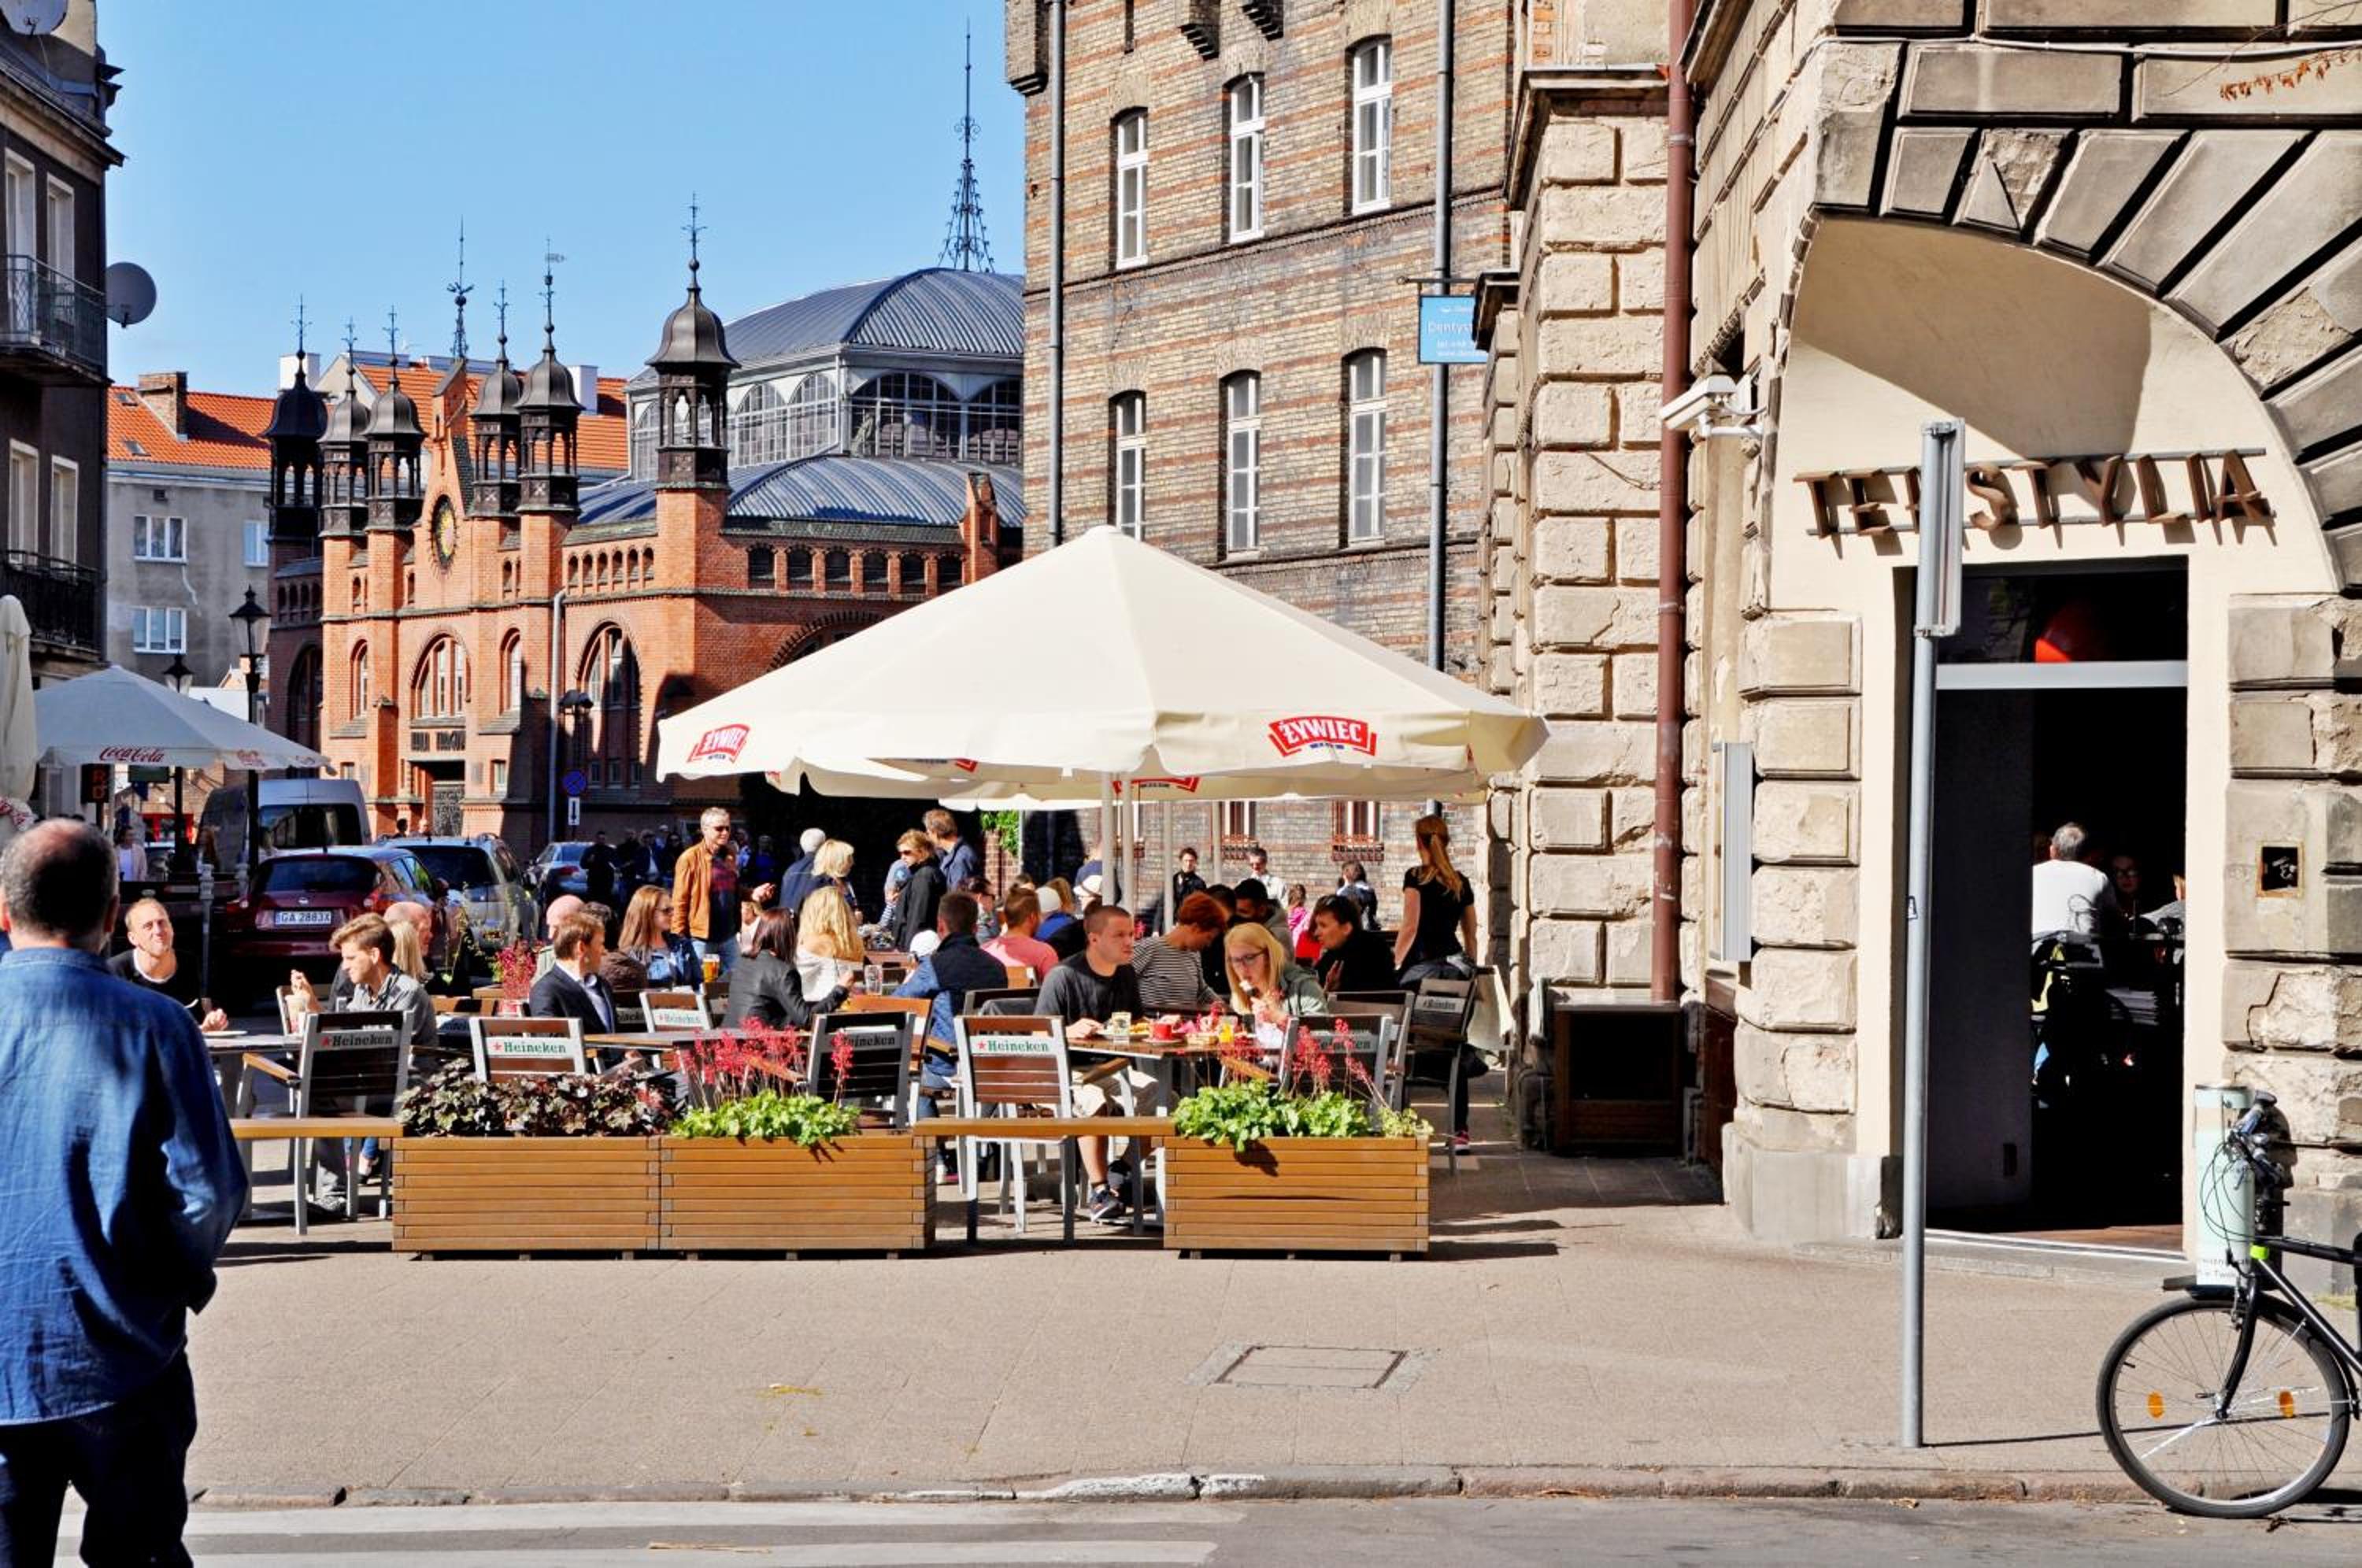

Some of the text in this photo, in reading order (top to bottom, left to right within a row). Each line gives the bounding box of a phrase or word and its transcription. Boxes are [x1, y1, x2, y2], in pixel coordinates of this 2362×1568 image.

[1792, 448, 2265, 538] TESTYLIA
[1278, 717, 1362, 744] ŻYWIEC
[332, 1034, 393, 1047] Heineken
[987, 1039, 1050, 1052] Heineken
[503, 1041, 567, 1054] Heineken
